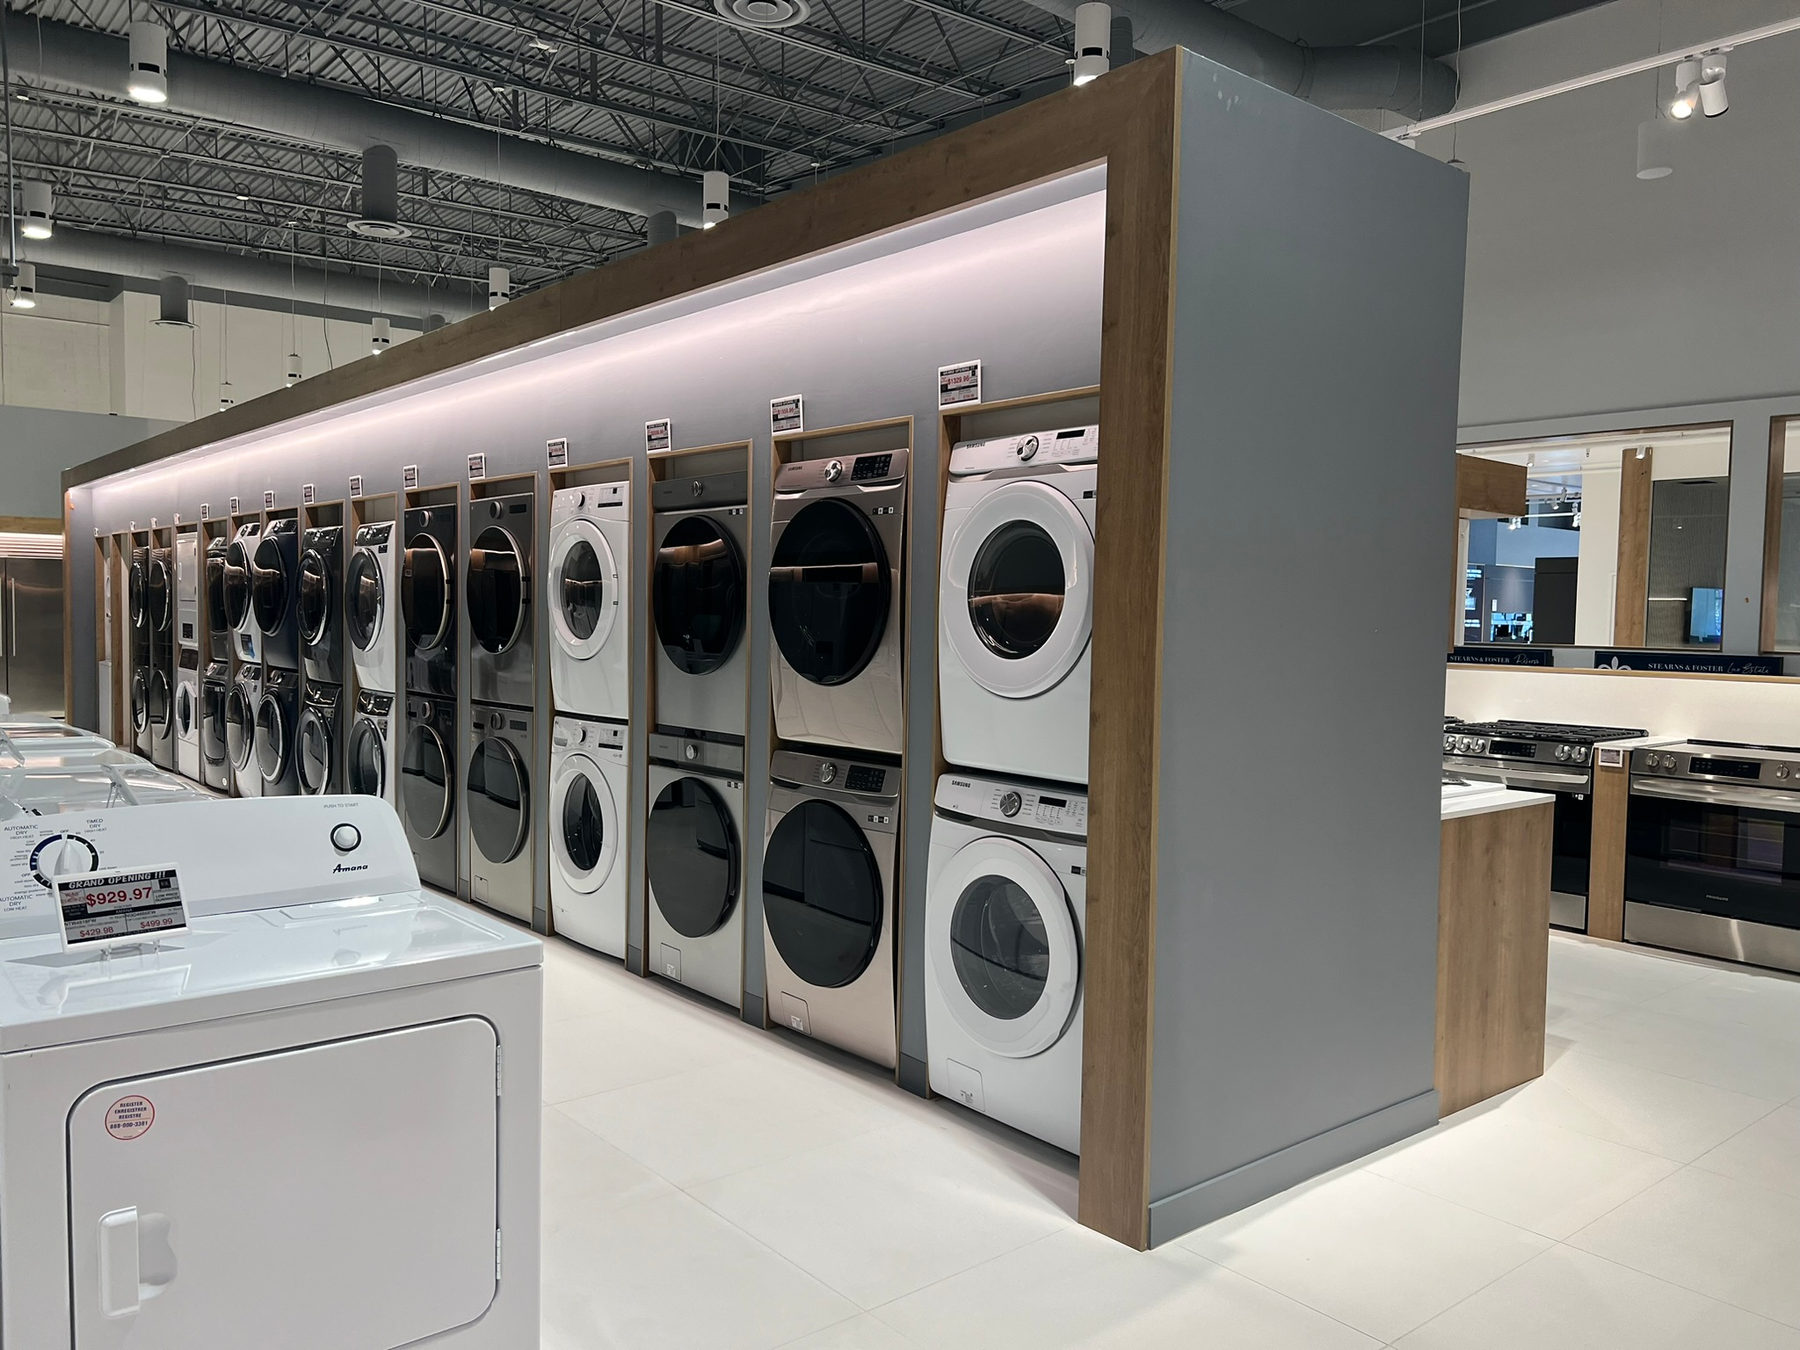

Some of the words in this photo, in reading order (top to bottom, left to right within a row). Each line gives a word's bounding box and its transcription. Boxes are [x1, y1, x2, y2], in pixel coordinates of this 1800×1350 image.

[332, 864, 368, 874] Amana
[68, 878, 104, 889] GRAND
[108, 872, 151, 884] OPENING
[154, 870, 166, 879] !!!
[85, 886, 152, 907] $929.97
[80, 926, 114, 938] $429.98
[140, 918, 173, 929] $499.99
